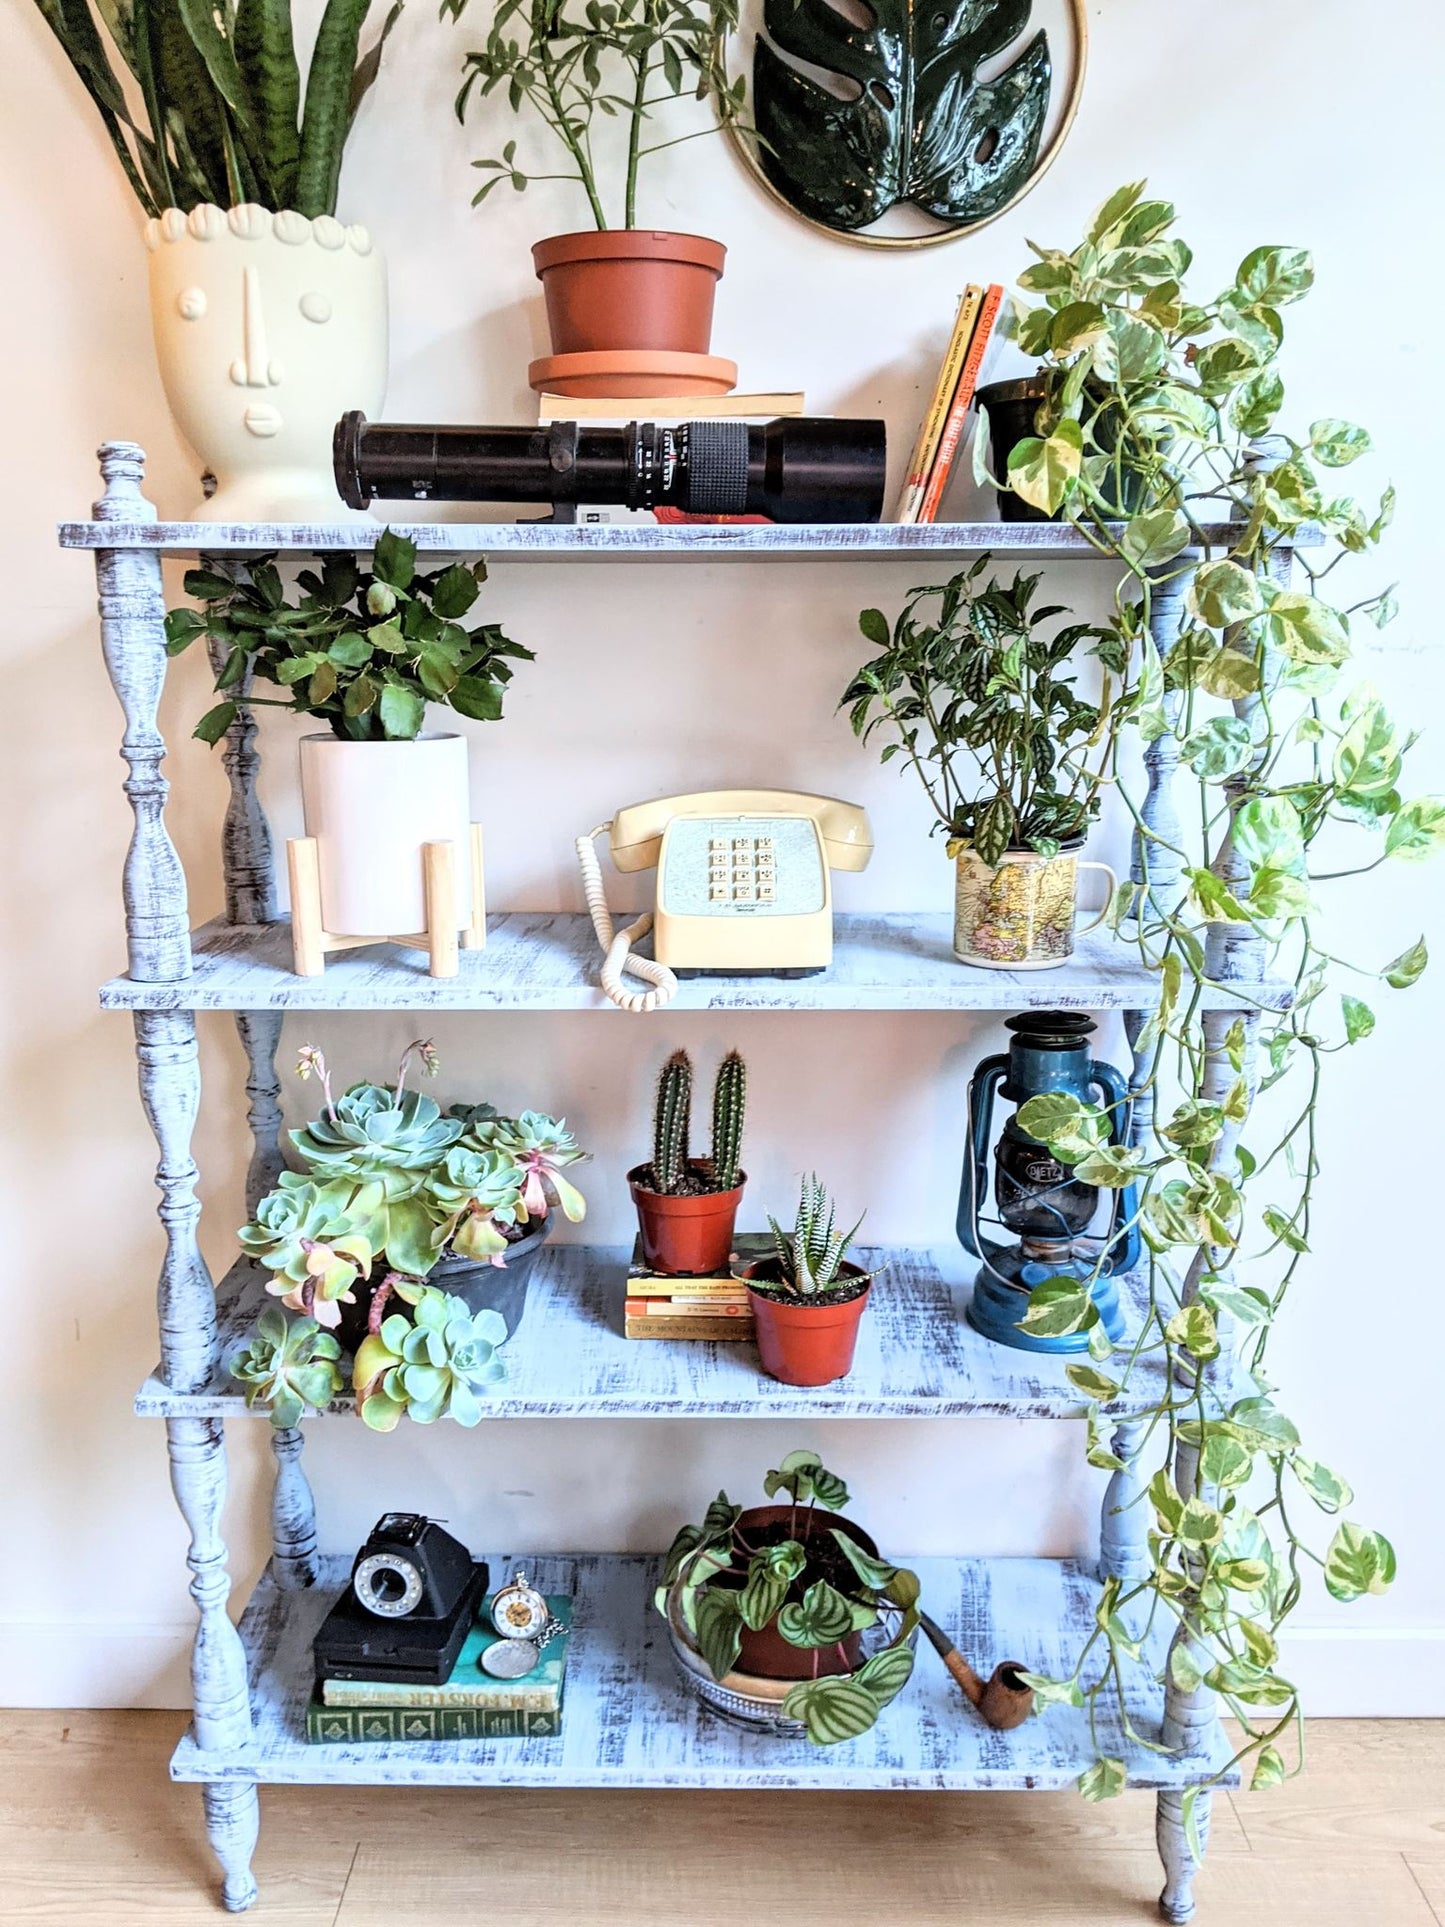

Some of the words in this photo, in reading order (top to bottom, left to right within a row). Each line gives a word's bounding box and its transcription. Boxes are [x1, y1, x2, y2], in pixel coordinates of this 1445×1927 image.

[978, 305, 997, 340] SCOTT
[940, 363, 954, 397] DICTIONARY
[958, 342, 986, 405] FITZGERALD
[1030, 1166, 1058, 1177] DIETZ
[410, 1693, 501, 1708] FORSTER
